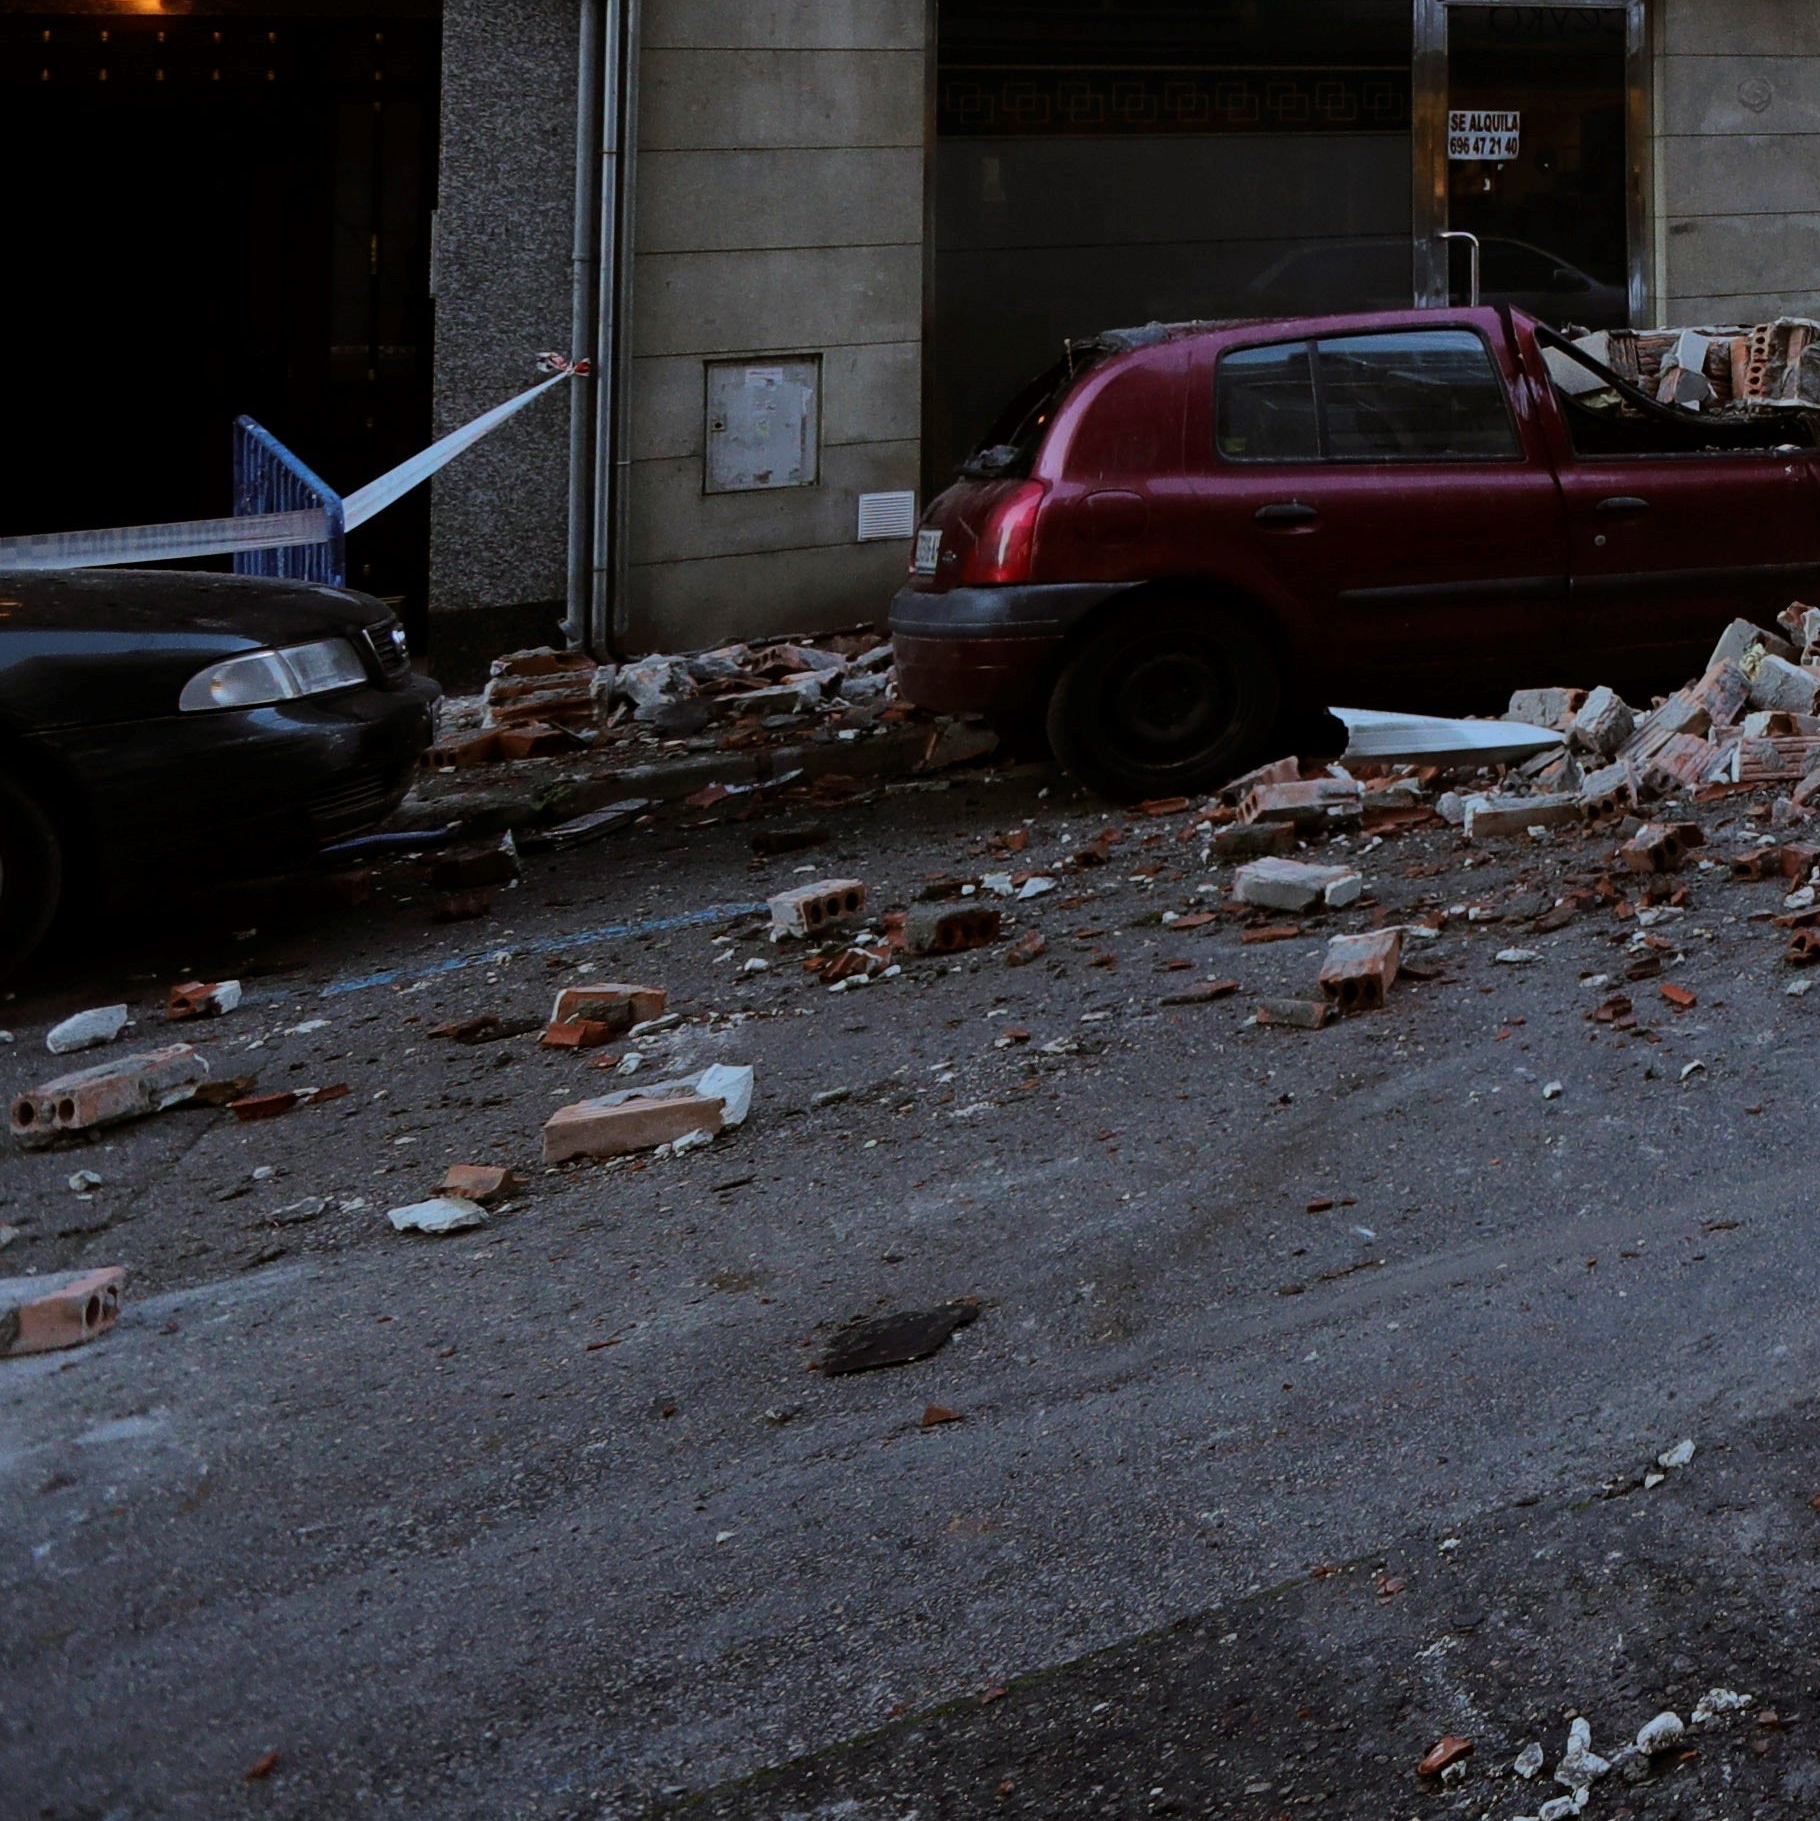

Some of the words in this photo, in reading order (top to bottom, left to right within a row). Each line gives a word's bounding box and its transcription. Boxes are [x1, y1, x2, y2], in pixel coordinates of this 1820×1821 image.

[1450, 113, 1466, 132] SE
[1469, 113, 1519, 133] ALQUILA
[1450, 136, 1470, 155] 696
[1473, 136, 1486, 155] 47
[1489, 136, 1502, 155] 21
[1505, 136, 1518, 155] 40
